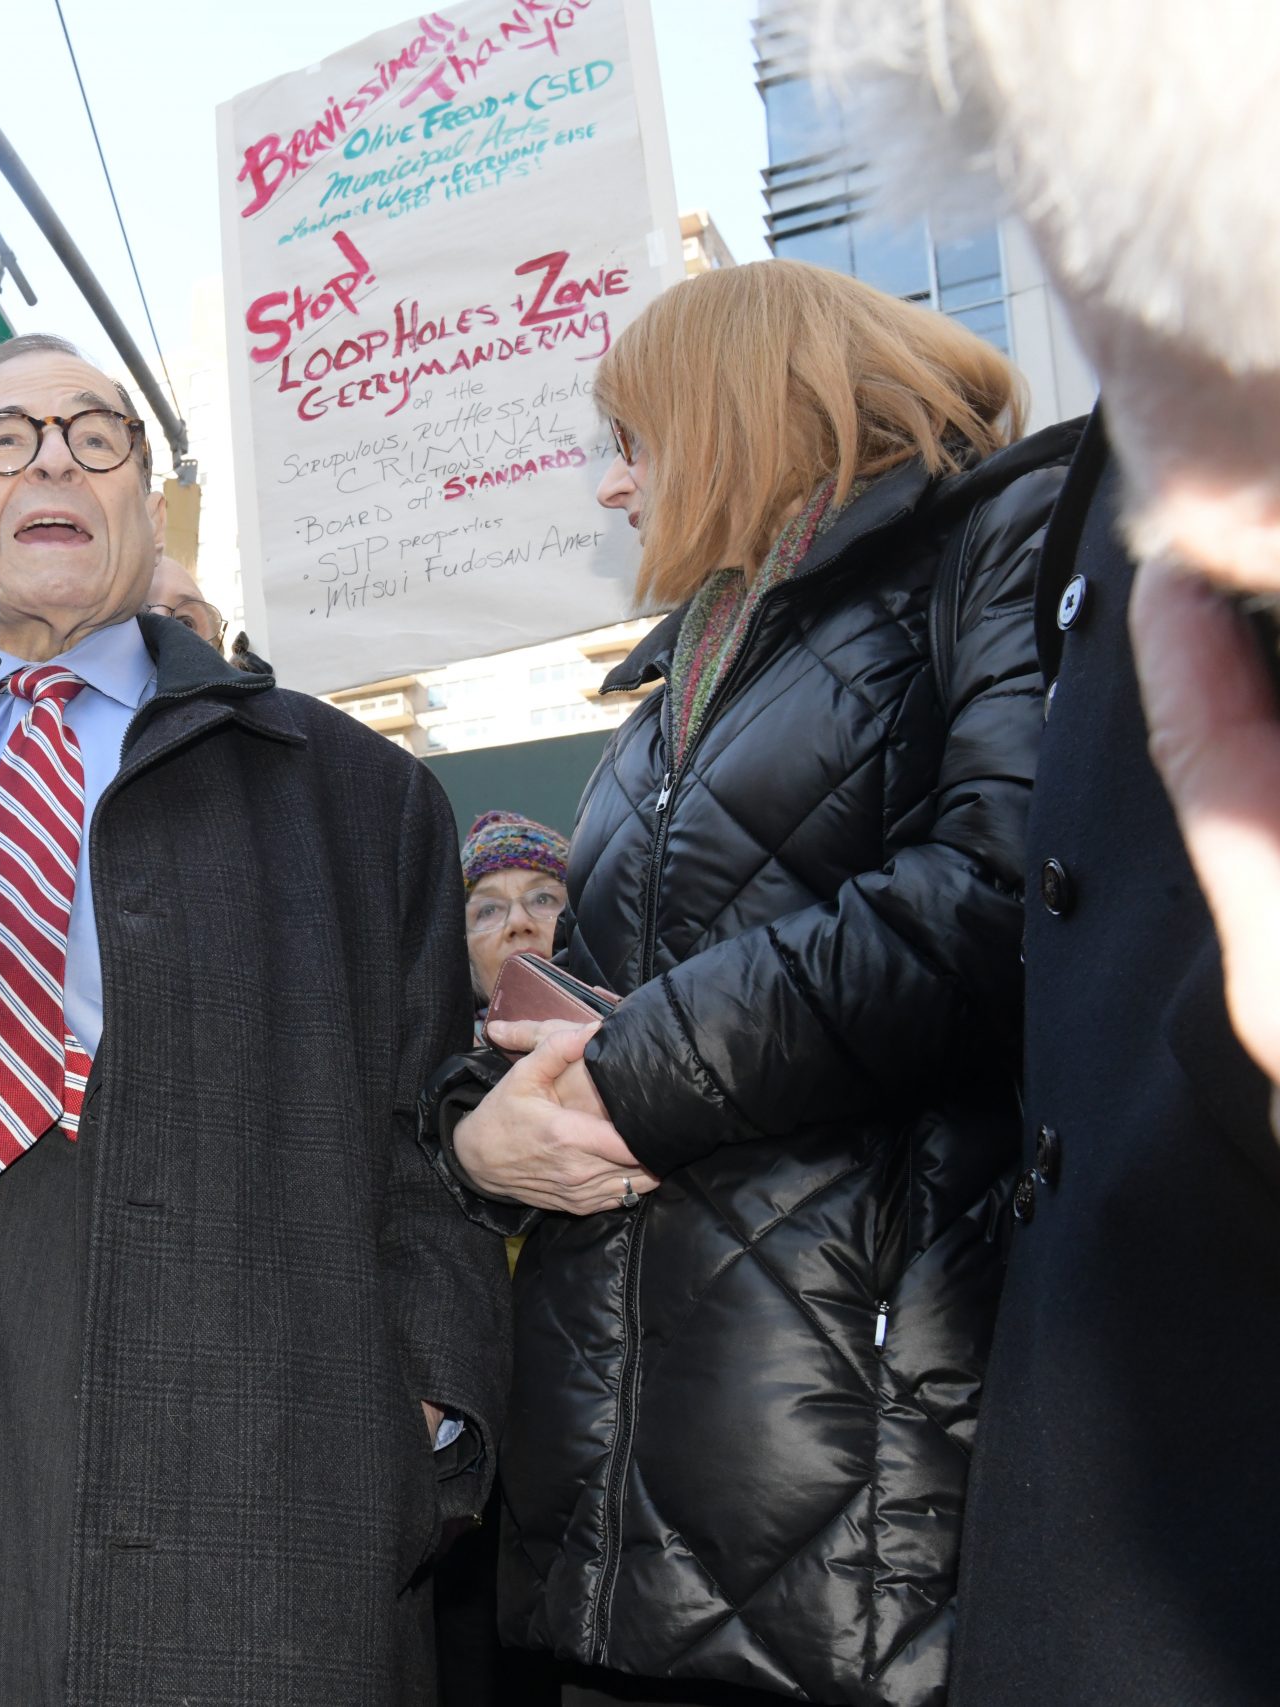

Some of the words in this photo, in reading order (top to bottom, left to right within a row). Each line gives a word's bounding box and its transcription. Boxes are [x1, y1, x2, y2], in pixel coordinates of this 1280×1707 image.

[343, 124, 415, 160] Olive
[524, 60, 614, 110] CSED
[318, 535, 388, 584] SJP
